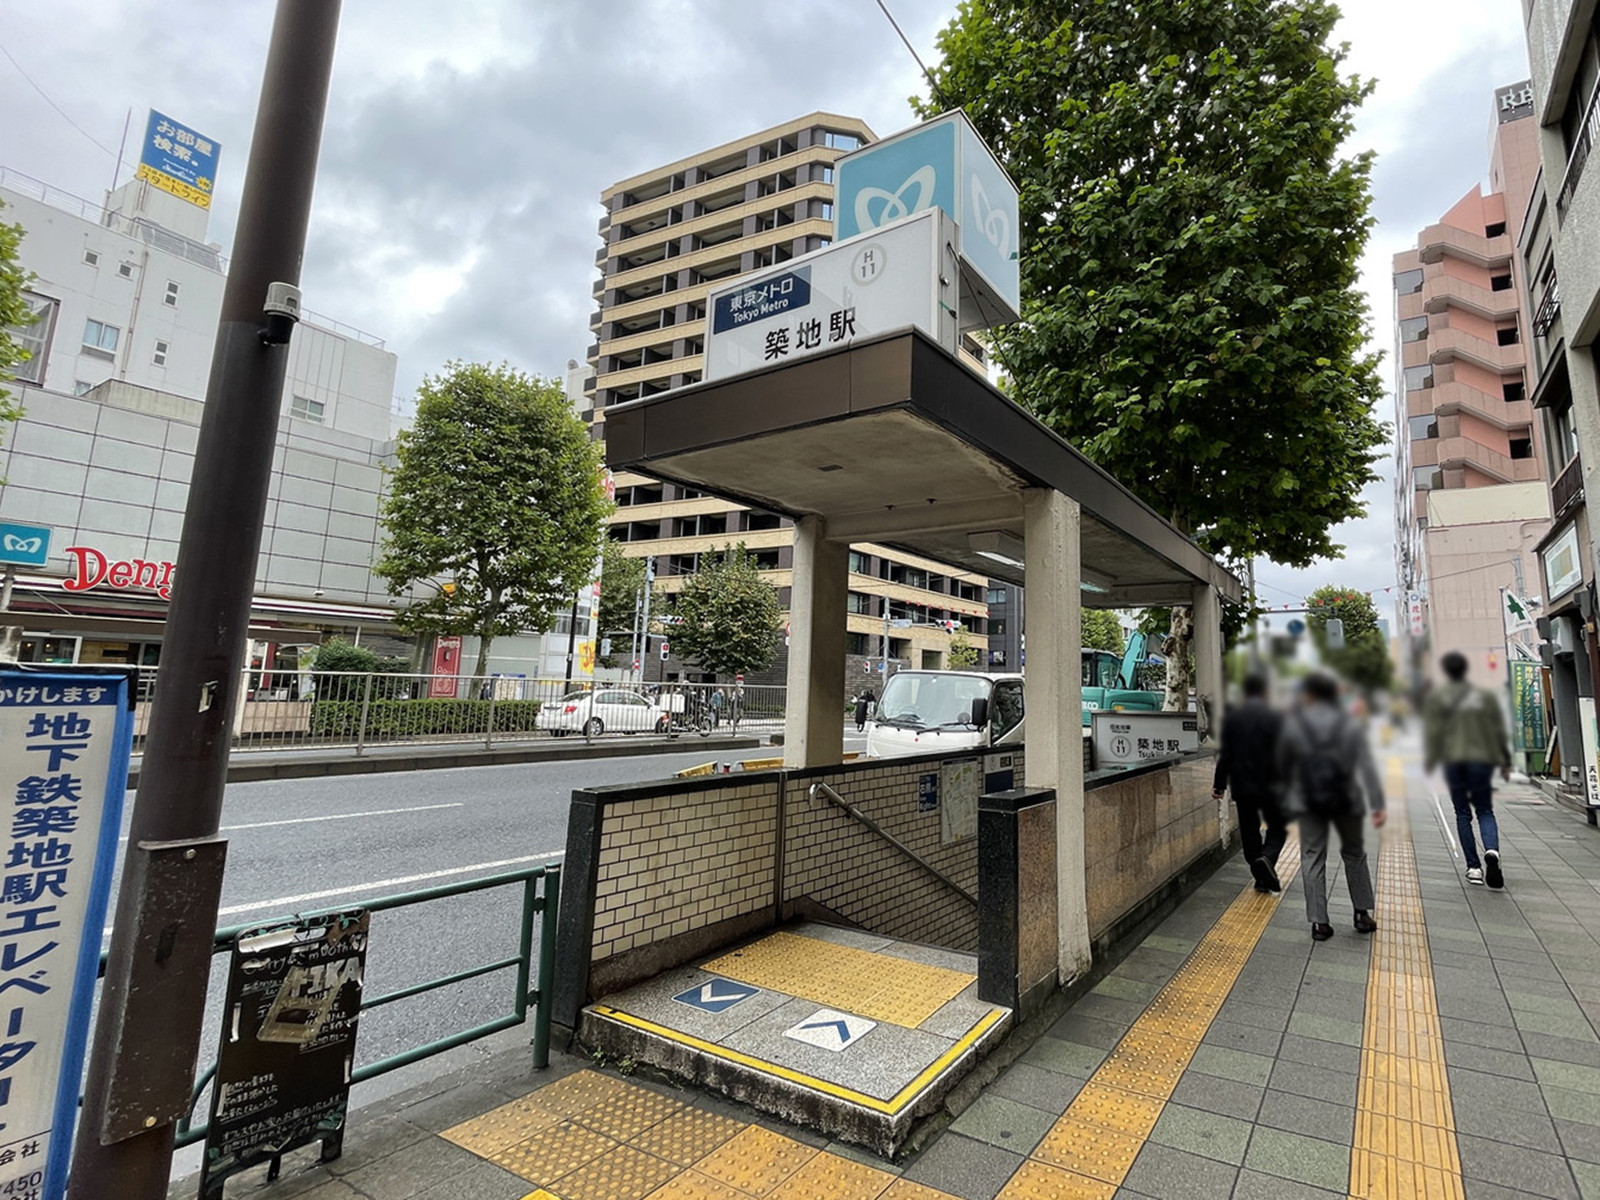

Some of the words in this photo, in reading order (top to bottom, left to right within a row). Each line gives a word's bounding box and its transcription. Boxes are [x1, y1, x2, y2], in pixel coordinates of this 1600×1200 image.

[153, 134, 198, 166] 検索。
[156, 120, 212, 157] お部屋
[864, 250, 873, 262] H
[861, 264, 875, 278] 11
[730, 277, 793, 313] 東京メトロ
[733, 307, 760, 323] Tokyo
[761, 298, 789, 316] Metro
[764, 307, 856, 360] 築地駅
[62, 546, 177, 600] Denn
[1116, 746, 1126, 754] 11
[1137, 738, 1179, 752] 築地駅
